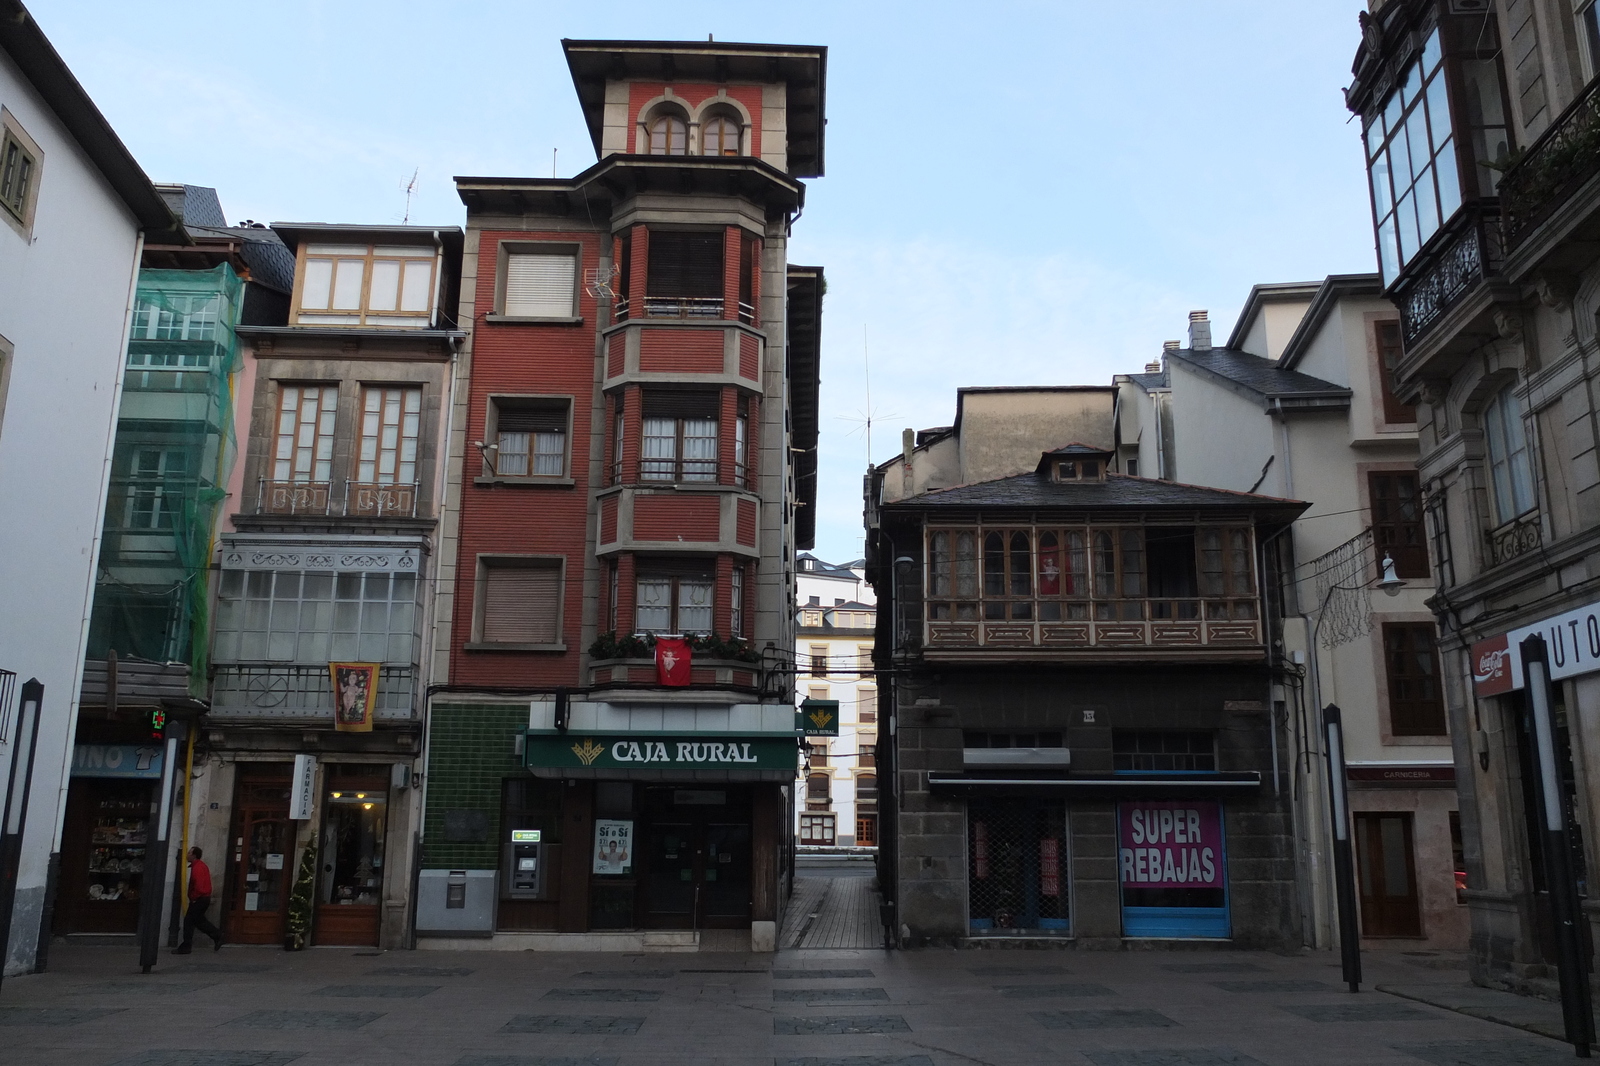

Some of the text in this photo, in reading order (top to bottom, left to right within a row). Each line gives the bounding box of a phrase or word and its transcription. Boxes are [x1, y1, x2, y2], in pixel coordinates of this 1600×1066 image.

[1537, 613, 1600, 668] UTO
[1480, 649, 1503, 673] Coca-Cola
[73, 745, 123, 769] INO
[611, 741, 758, 763] CAJA RURAL
[302, 758, 312, 816] FARMACIA
[1383, 771, 1431, 779] CARNICERIA
[599, 826, 610, 837] Sí
[618, 827, 629, 838] Sí
[1131, 808, 1202, 845] SUPER
[1121, 847, 1216, 883] REBAJAS
